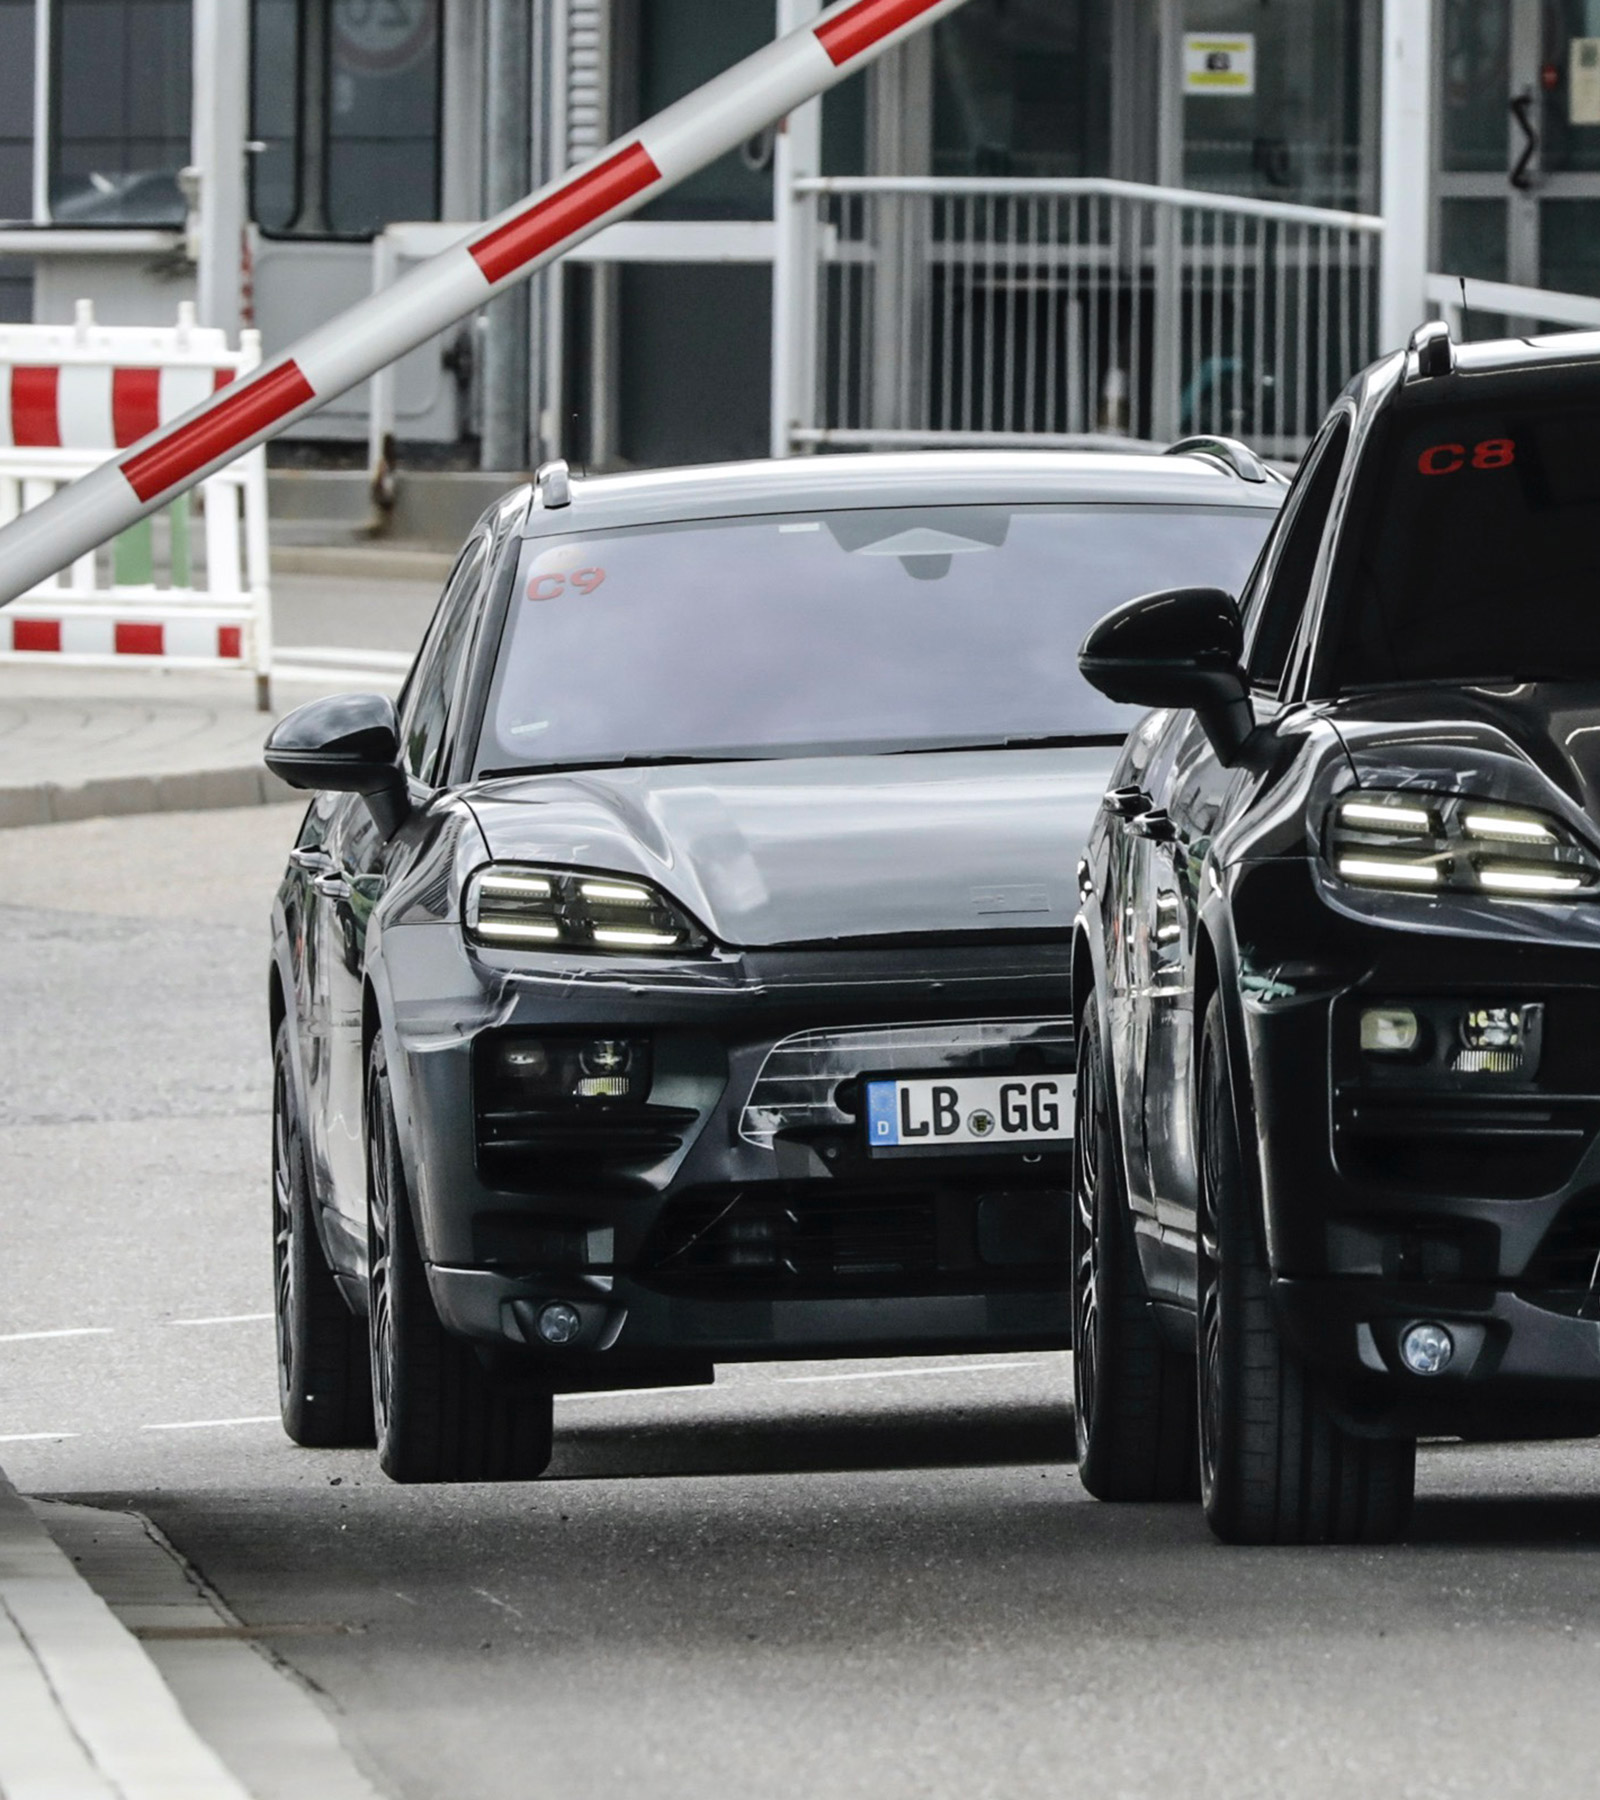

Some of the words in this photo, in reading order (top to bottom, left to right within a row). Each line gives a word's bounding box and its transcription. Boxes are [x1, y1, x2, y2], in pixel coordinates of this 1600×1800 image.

[1418, 438, 1516, 475] C8
[527, 567, 606, 601] C9
[901, 1086, 960, 1137] LB
[1000, 1082, 1059, 1133] GG
[877, 1121, 889, 1135] D
